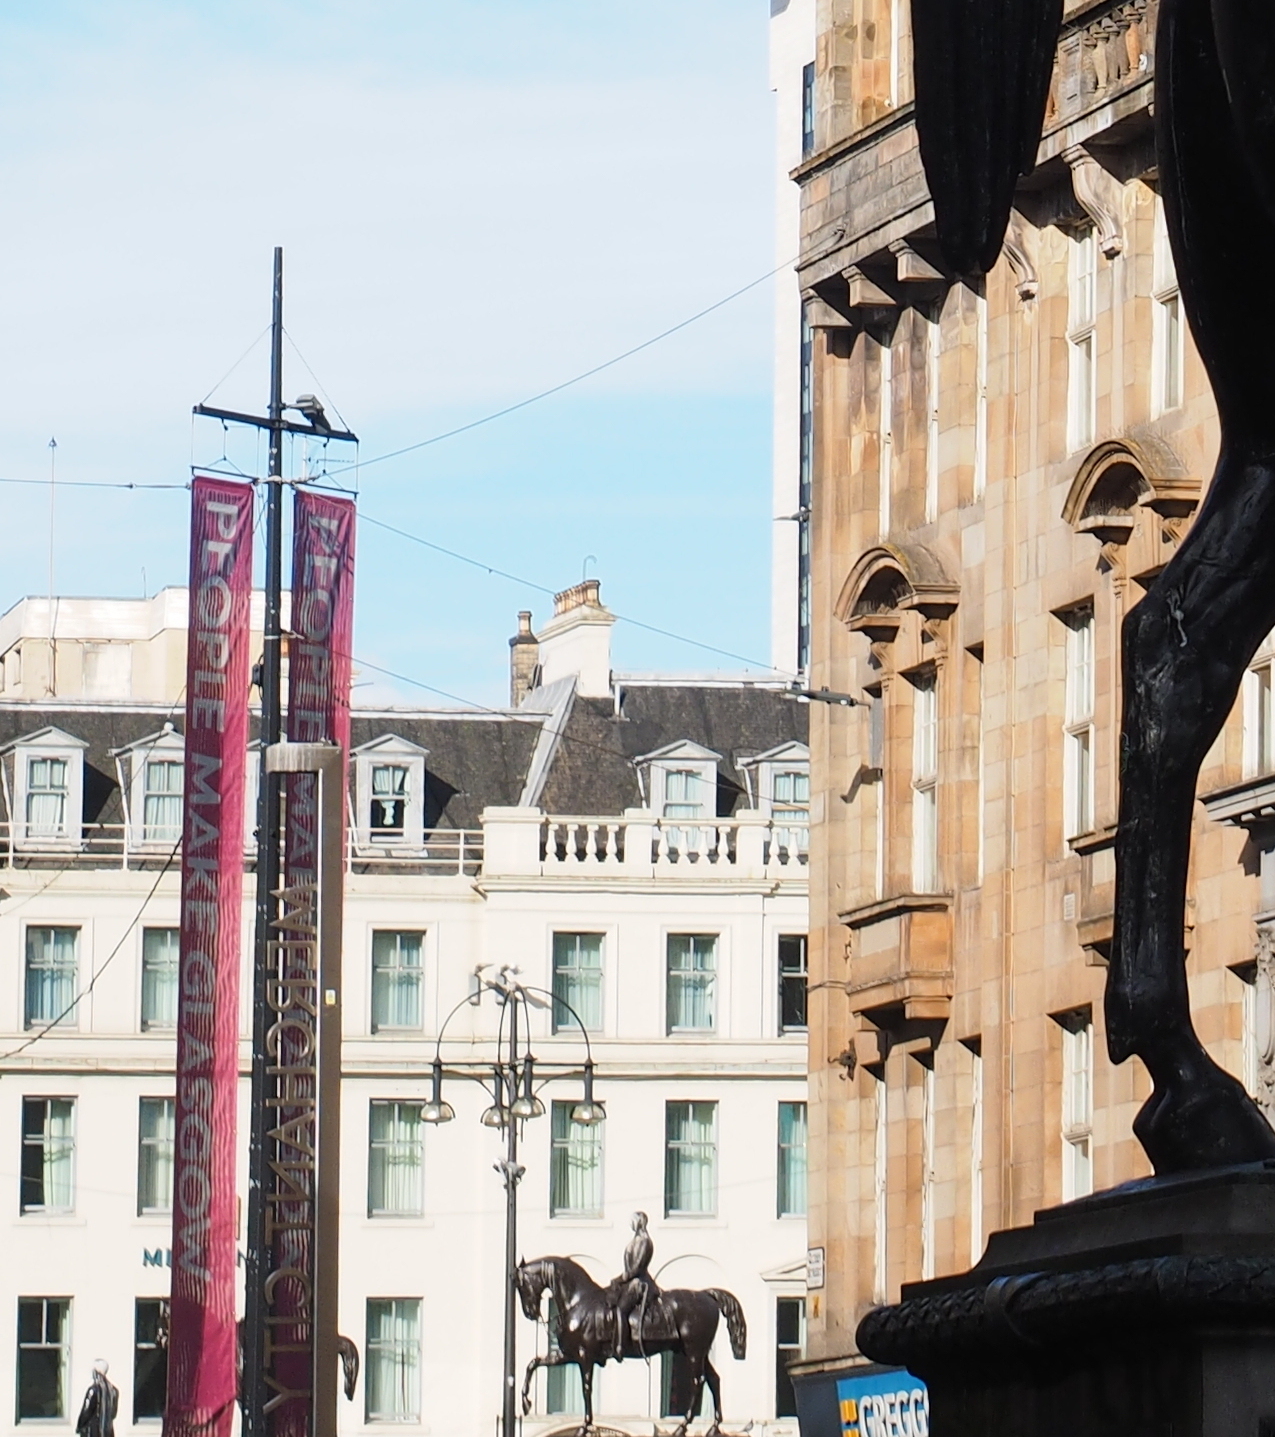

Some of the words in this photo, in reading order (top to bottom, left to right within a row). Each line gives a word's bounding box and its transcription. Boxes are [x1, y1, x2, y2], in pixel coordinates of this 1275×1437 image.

[191, 501, 239, 733] PEOPLE
[183, 751, 222, 935] MAKE
[178, 950, 216, 1282] GLASGOW
